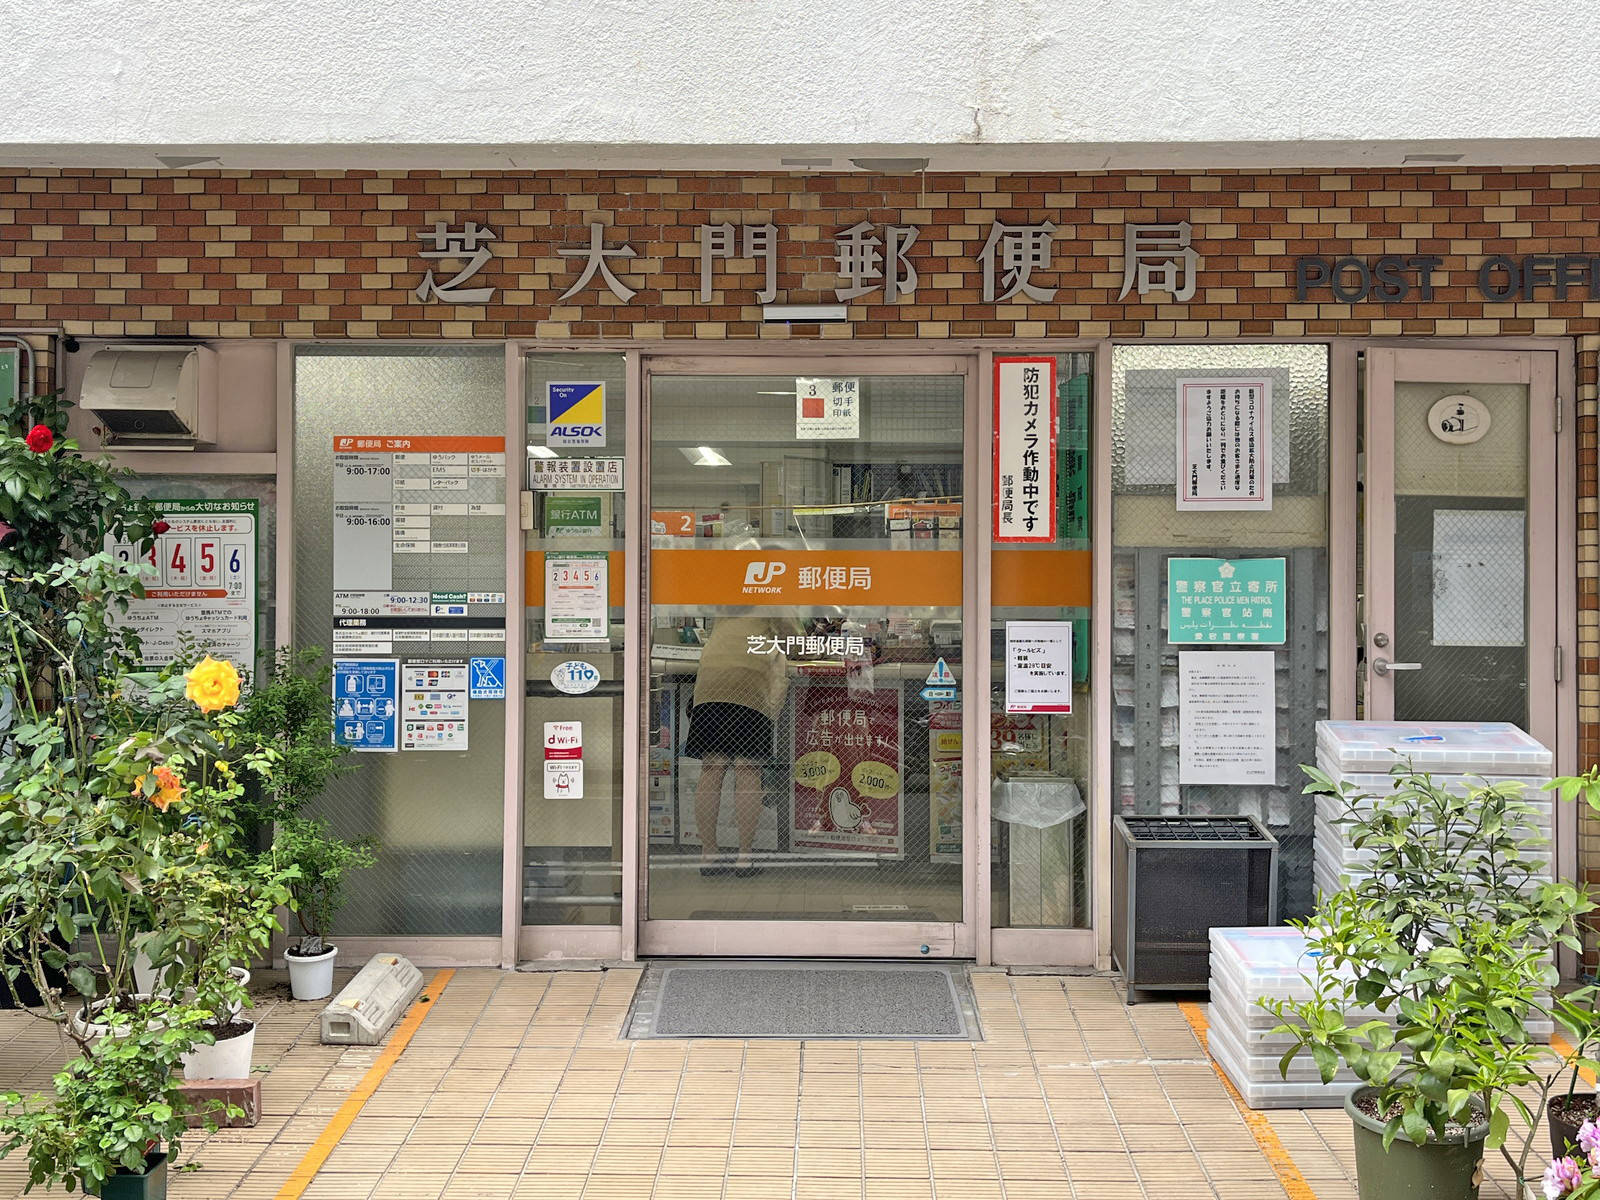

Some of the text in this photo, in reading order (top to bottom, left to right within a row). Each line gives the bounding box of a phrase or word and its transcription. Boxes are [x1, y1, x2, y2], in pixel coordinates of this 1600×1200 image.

[414, 219, 1201, 305] 芝大門郵便局
[1296, 256, 1444, 303] POST
[552, 386, 575, 394] Security
[808, 384, 818, 397] 3
[832, 381, 856, 394] 郵便
[832, 396, 854, 407] 切手
[832, 408, 852, 418] 印紙
[550, 426, 602, 437] ALSOK
[356, 439, 411, 449] 郵便局 ご案内
[1022, 367, 1040, 533] 防犯カメラ作動中です
[346, 467, 391, 476] 9:00-17:00
[534, 460, 618, 473] 警報装置設置店
[533, 474, 619, 484] ALARM SYSTEM IN OPERATION
[1001, 474, 1014, 524] 郵便局長
[550, 509, 598, 520] 銀行ATM
[346, 517, 391, 526] 9:00-16:00
[680, 515, 692, 532] 2
[169, 524, 238, 532] ービスを休止します。
[118, 549, 129, 574] 2
[170, 543, 187, 573] 4
[200, 543, 215, 573] 5
[229, 549, 240, 573] 6
[553, 572, 558, 582] 2
[563, 570, 569, 581] 3
[573, 570, 579, 581] 4
[584, 570, 590, 581] 5
[594, 572, 599, 581] 6
[743, 561, 787, 584] JP
[798, 565, 872, 591] 郵便局
[742, 586, 783, 594] NETWORK
[1175, 580, 1278, 593] 警察官立寄所
[151, 590, 208, 598] ご利用いただけません
[390, 596, 428, 604] 9:00-12:30
[1181, 595, 1273, 605] THE PLACE POLICE MEN PATROL
[341, 607, 380, 615] 9:00-18:00
[338, 618, 367, 627] 代理業務
[1194, 632, 1260, 641] 愛宕警察署
[746, 635, 864, 656] 芝大門郵便局
[565, 662, 588, 670] 子ども
[819, 709, 876, 728] 郵便局で
[557, 736, 578, 744] Wi-Fi
